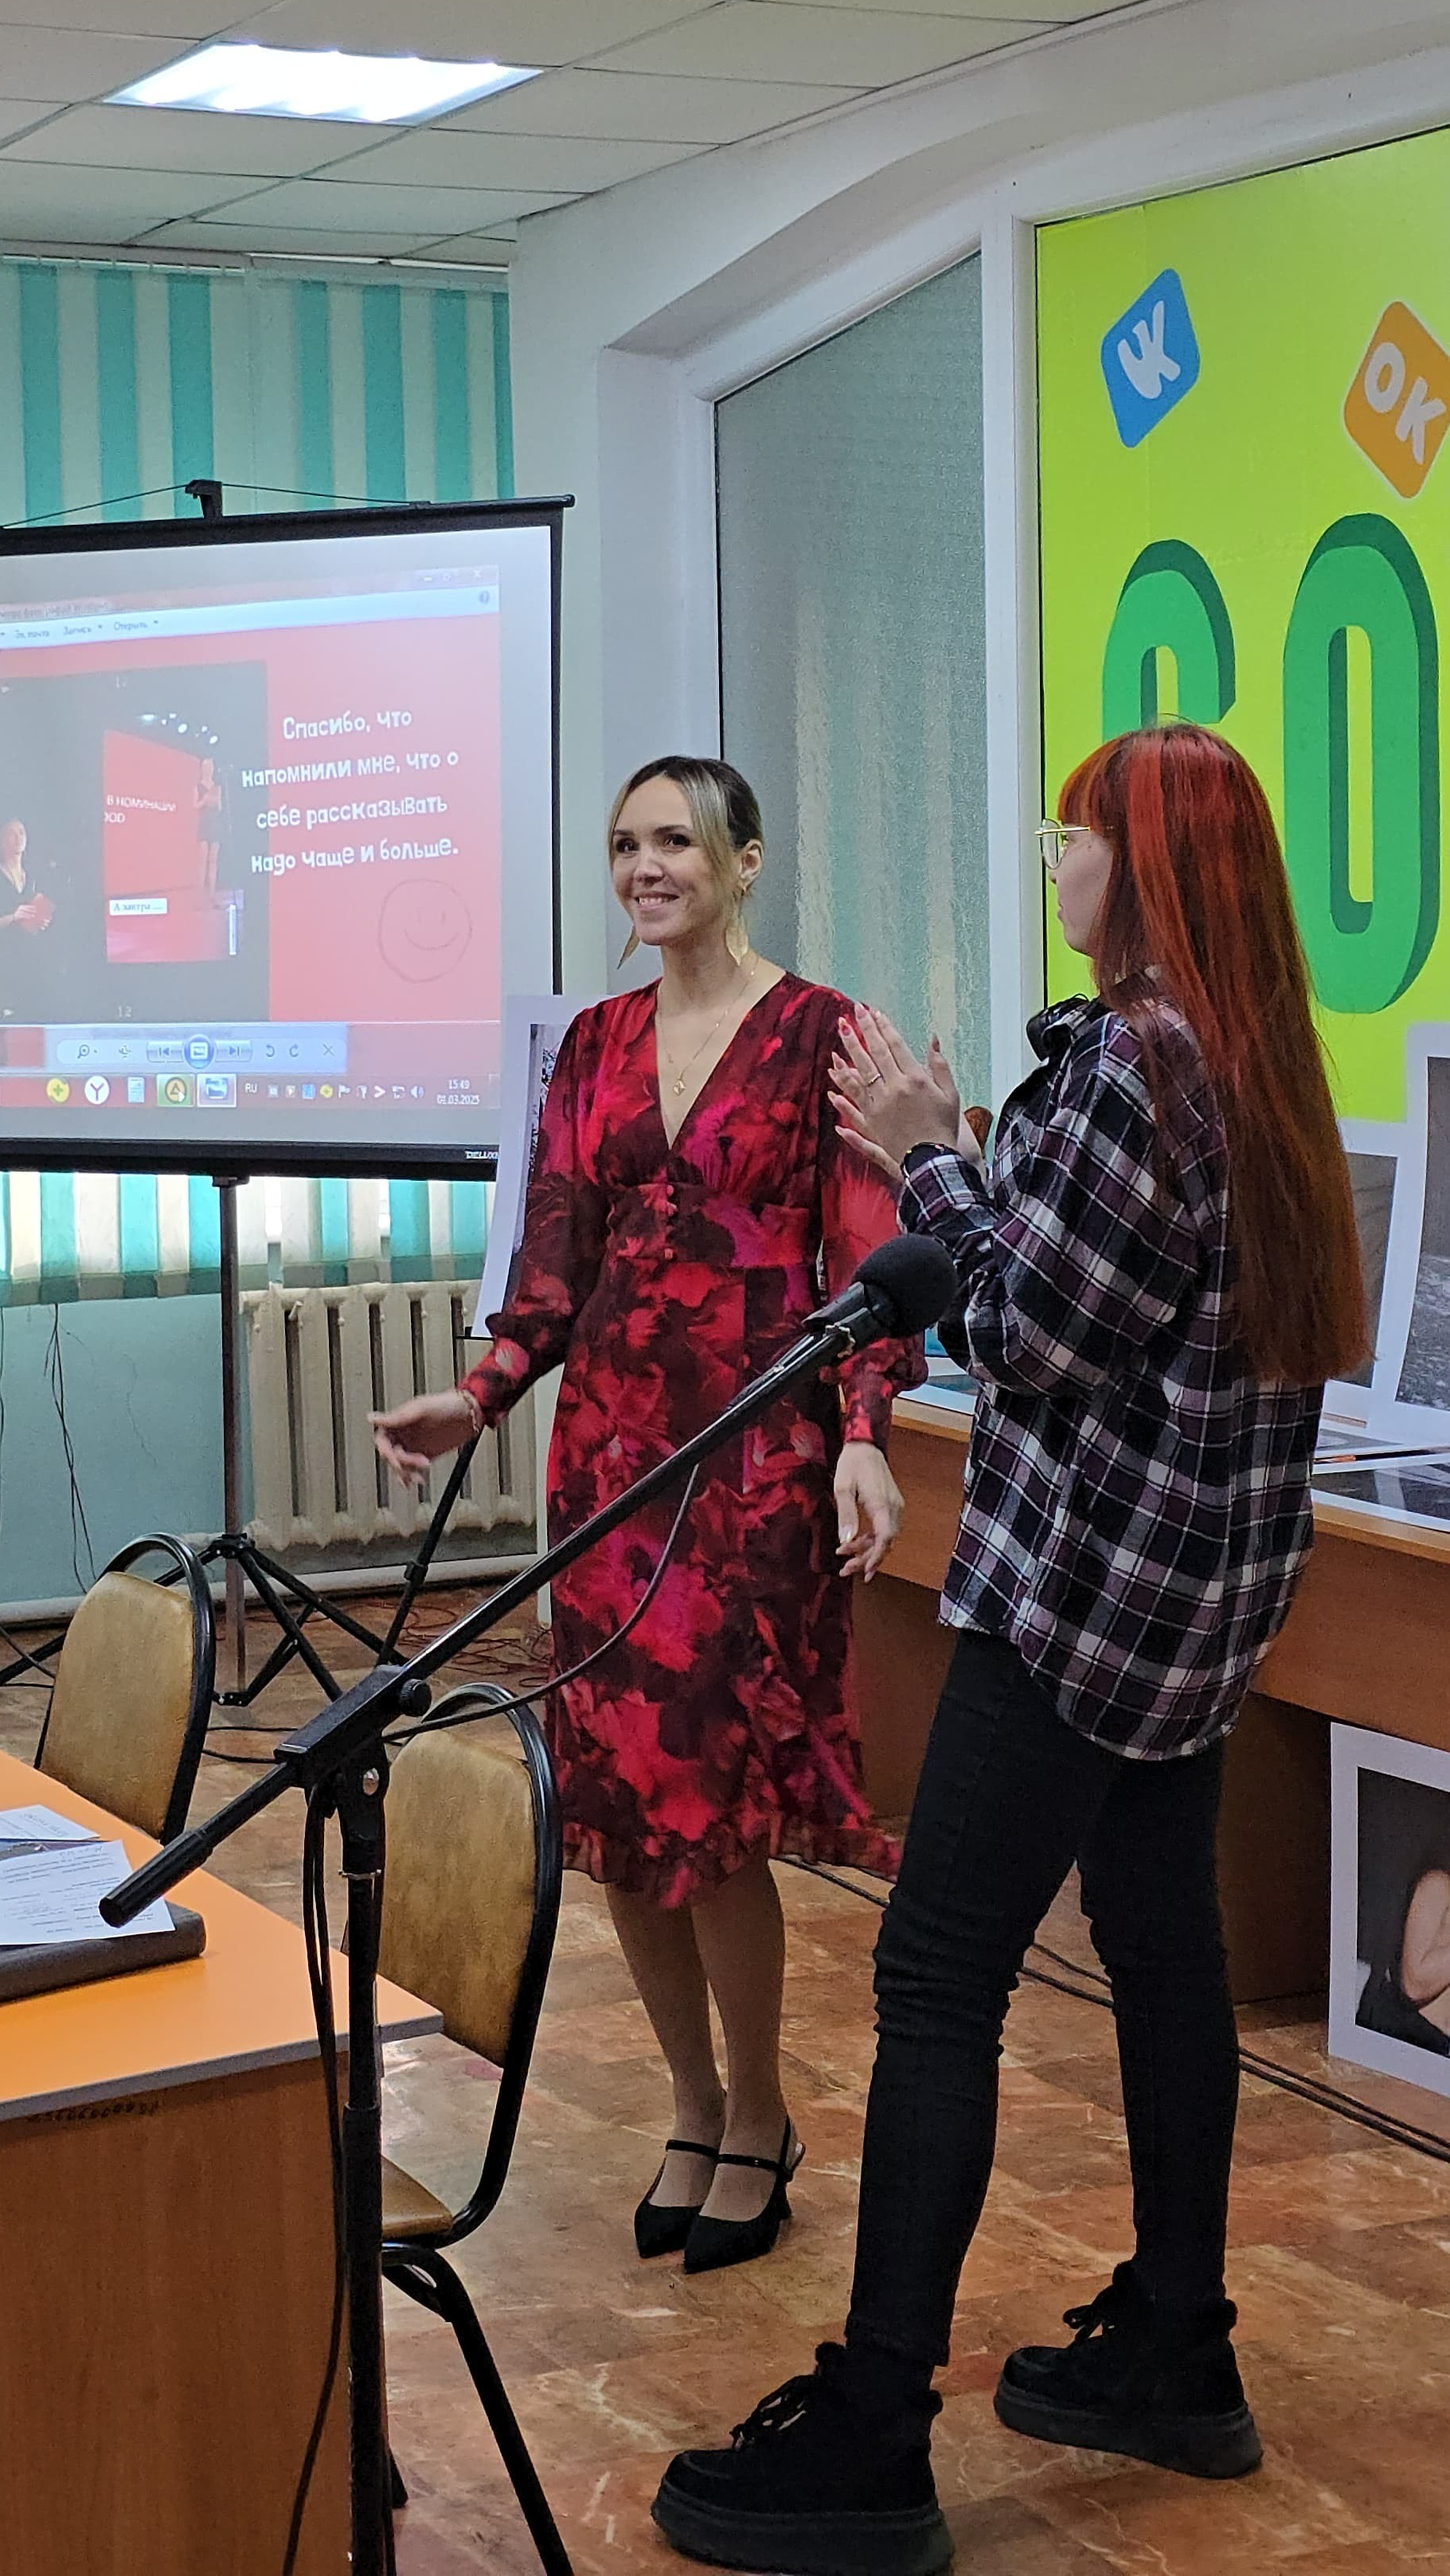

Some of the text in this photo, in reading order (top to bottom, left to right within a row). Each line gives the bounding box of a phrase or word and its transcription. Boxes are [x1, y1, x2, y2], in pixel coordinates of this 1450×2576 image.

[283, 709, 412, 740] Спасибо, что
[241, 751, 459, 788] напомнили мне, что о
[256, 795, 448, 831] себе рассказывать
[251, 837, 459, 876] надо чаще и больше.
[244, 1083, 257, 1093] RU
